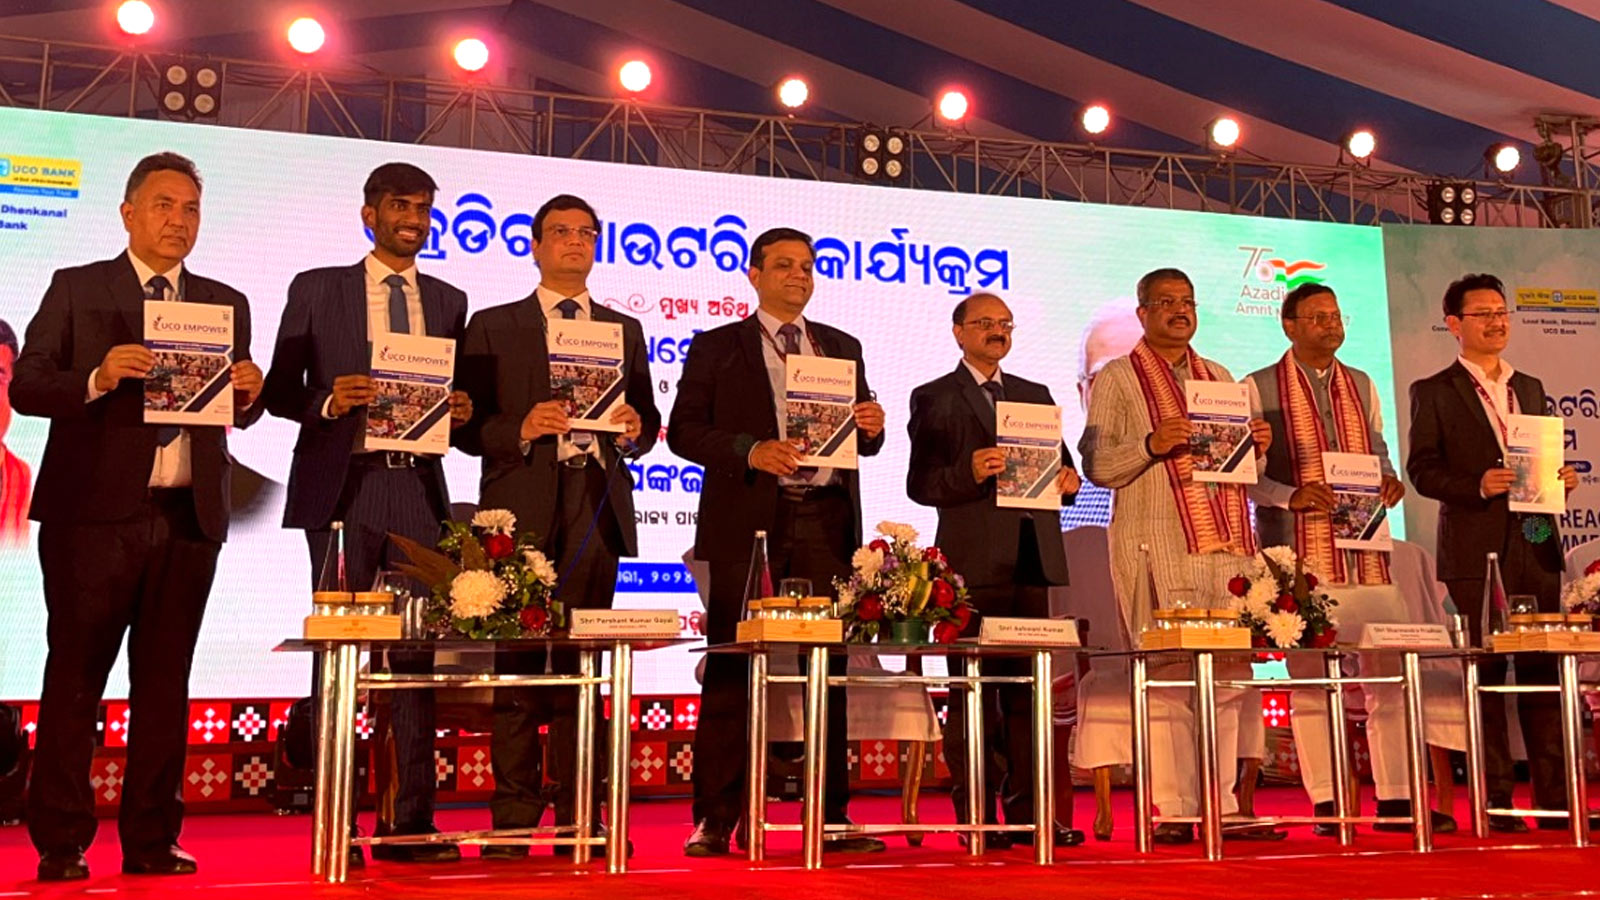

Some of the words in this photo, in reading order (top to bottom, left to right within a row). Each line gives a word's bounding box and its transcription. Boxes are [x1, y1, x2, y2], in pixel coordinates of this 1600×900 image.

[13, 165, 38, 174] UCO
[42, 167, 76, 178] BANK
[1, 204, 68, 218] Dhenkanal
[1236, 302, 1272, 315] Amrit
[161, 322, 181, 331] UCO
[183, 324, 229, 334] EMPOWER
[563, 338, 580, 346] UCO
[581, 340, 619, 350] EMPOWER
[388, 353, 406, 362] UCO
[407, 355, 450, 366] EMPOWER
